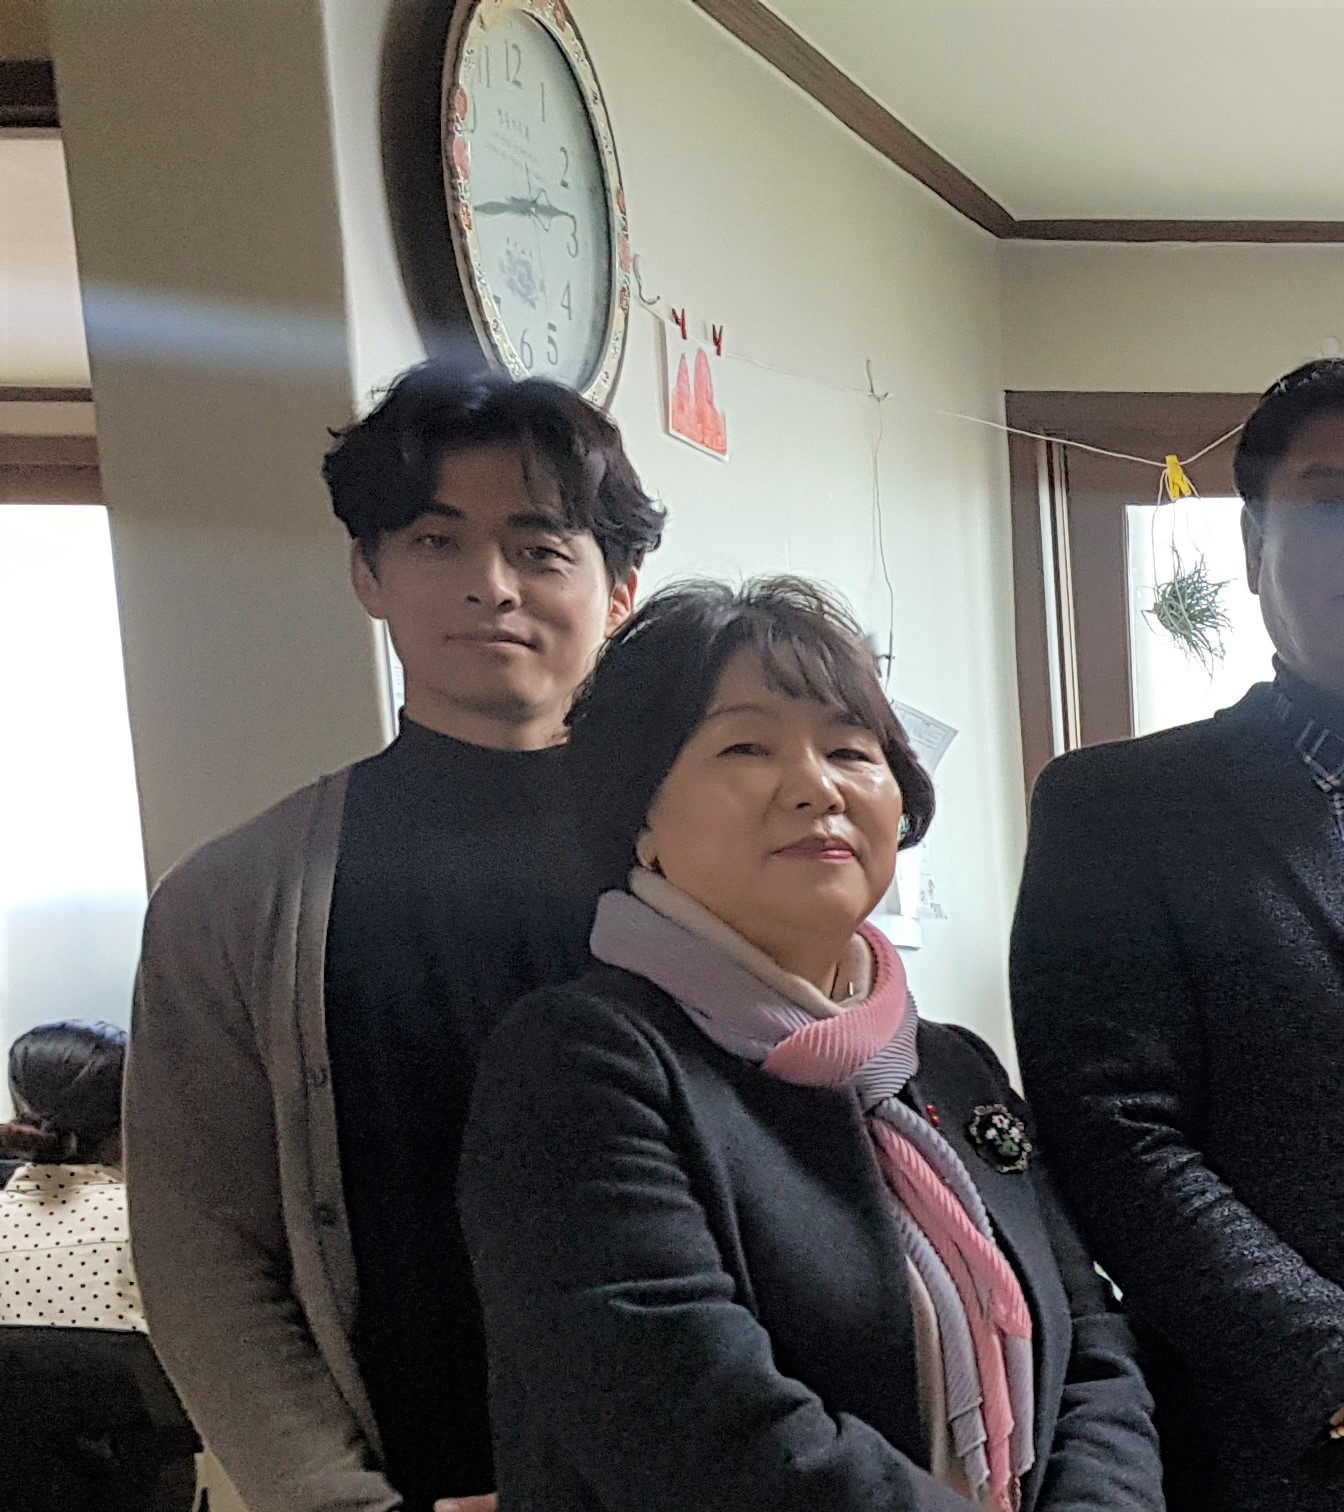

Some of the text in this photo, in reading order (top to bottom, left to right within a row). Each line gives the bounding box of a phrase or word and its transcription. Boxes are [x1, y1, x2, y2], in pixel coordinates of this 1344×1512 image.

[504, 39, 522, 88] 12
[559, 146, 570, 190] 2
[560, 281, 572, 321] 4
[519, 328, 534, 370] 6
[547, 321, 559, 366] 5
